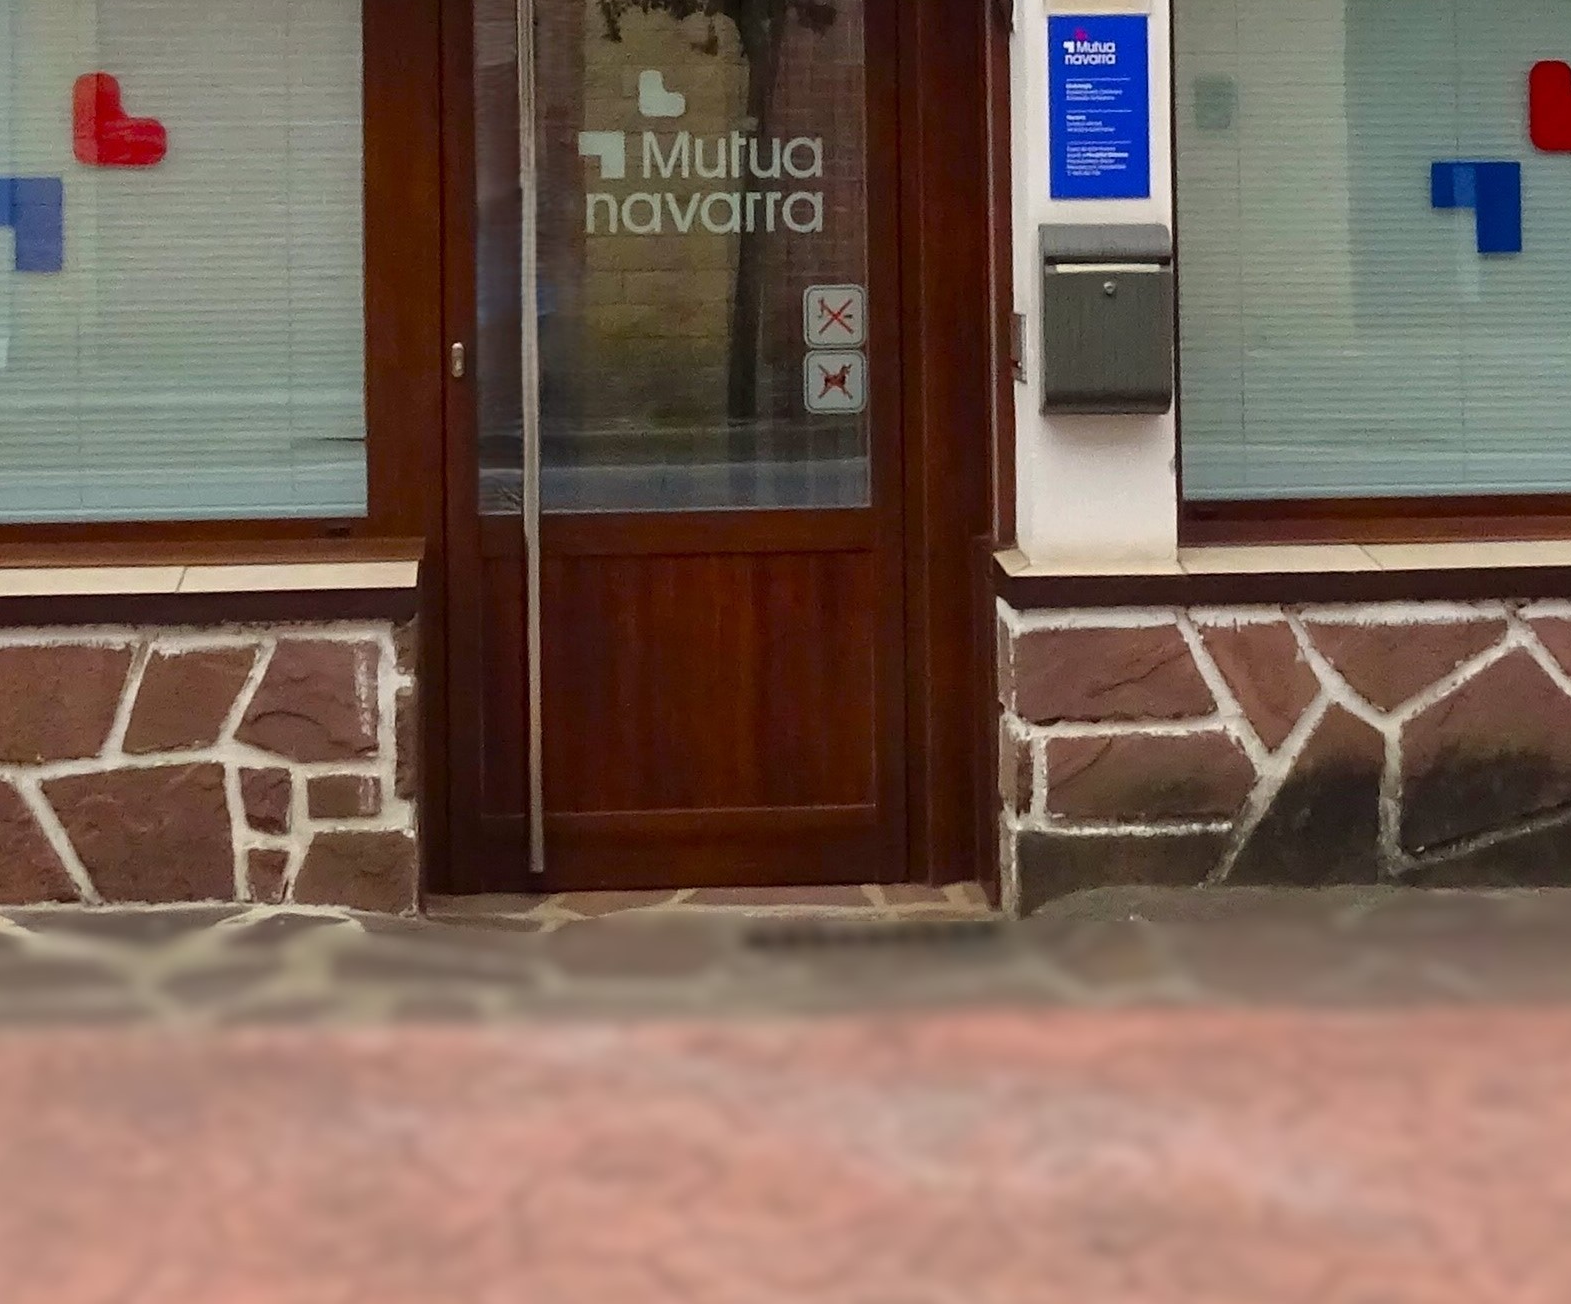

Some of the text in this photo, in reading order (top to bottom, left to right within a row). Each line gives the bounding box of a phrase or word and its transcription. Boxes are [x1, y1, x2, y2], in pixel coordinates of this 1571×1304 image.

[1064, 53, 1116, 66] navarra
[1076, 41, 1116, 54] Mutua
[642, 130, 824, 179] Mutua
[585, 190, 824, 234] navarra
